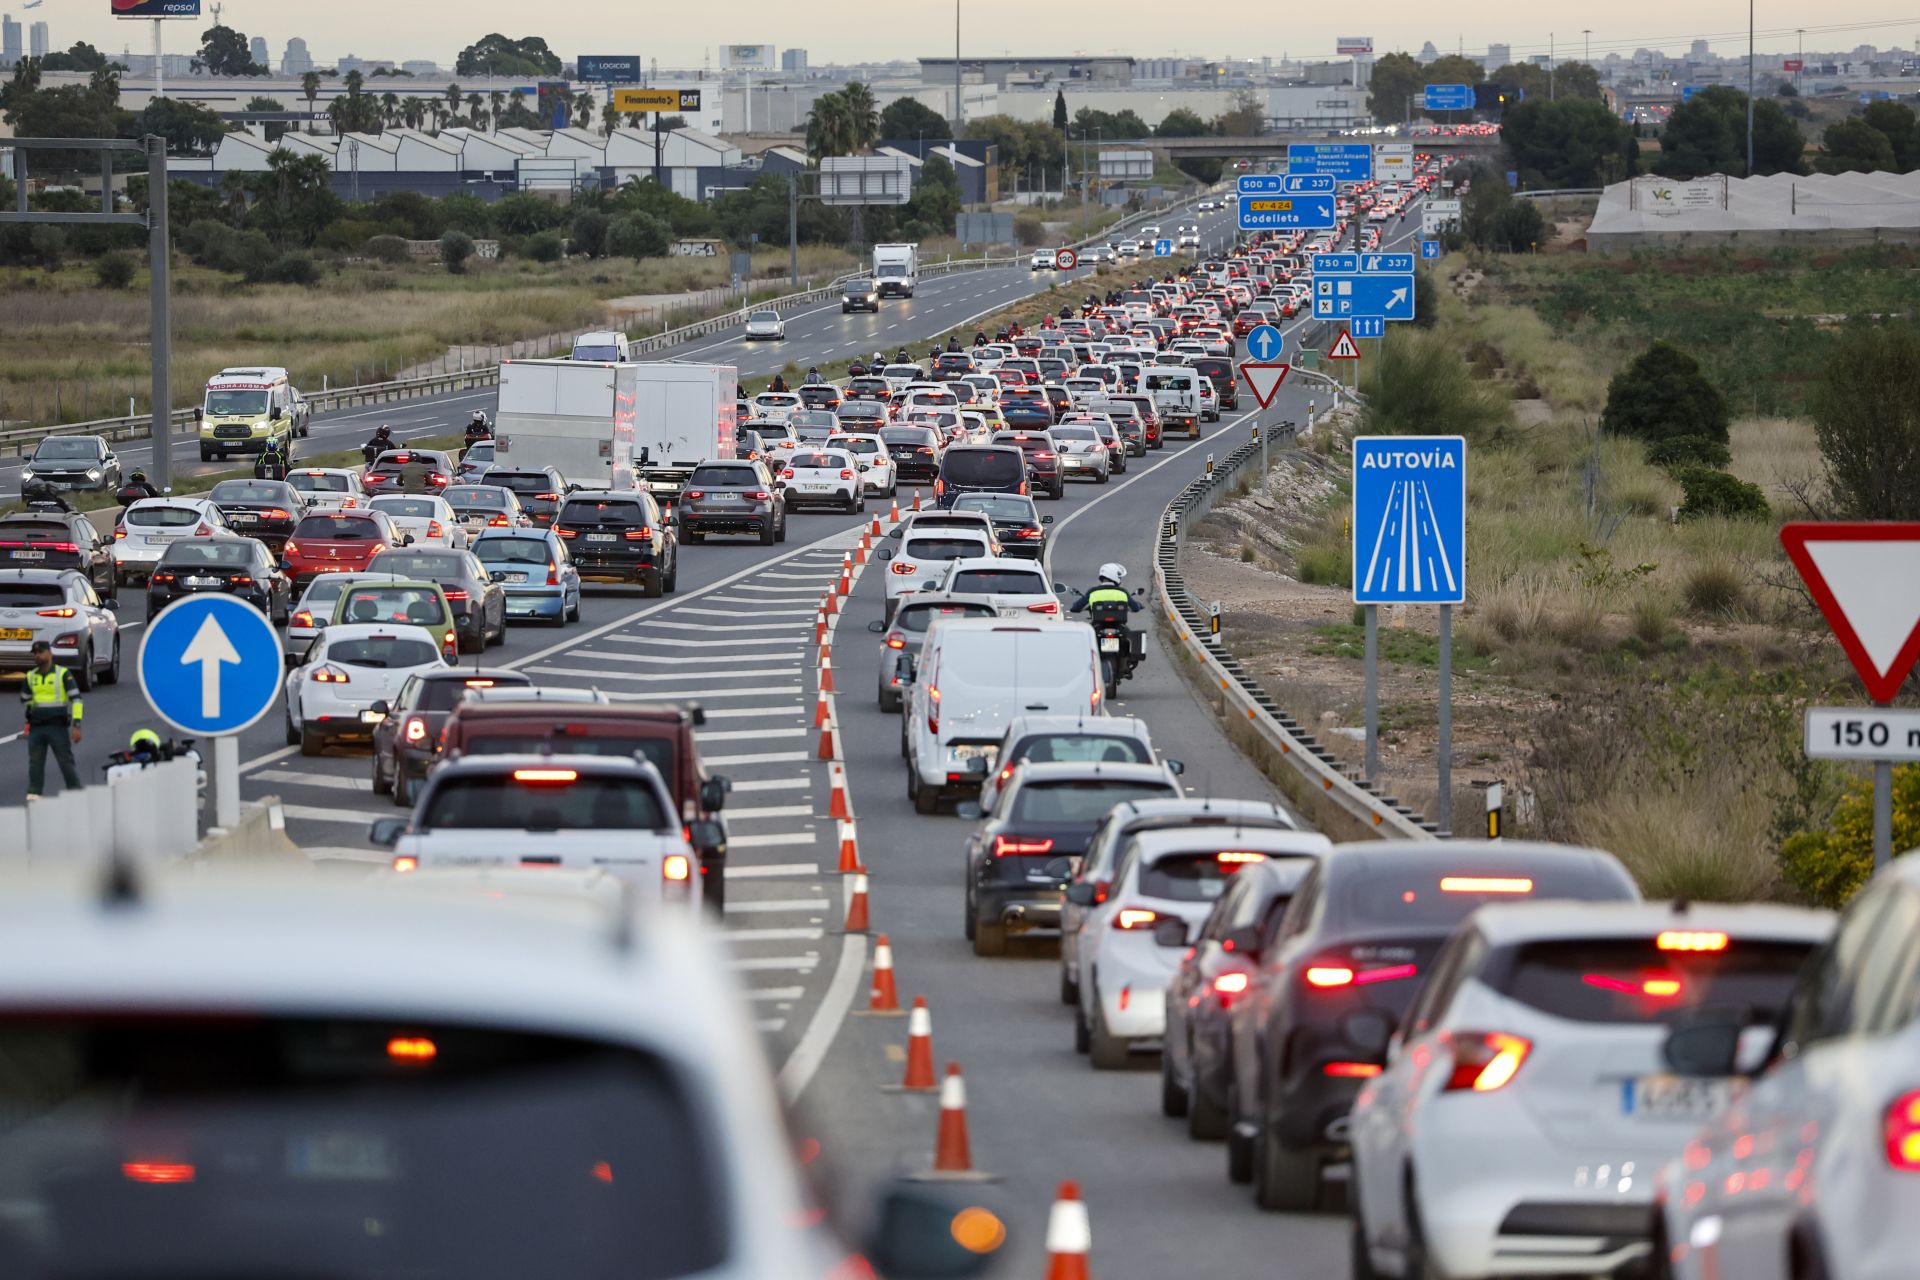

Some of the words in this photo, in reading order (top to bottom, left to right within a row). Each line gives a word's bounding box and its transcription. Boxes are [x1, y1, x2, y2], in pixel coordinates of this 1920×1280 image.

[163, 3, 195, 12] repsol
[598, 62, 630, 70] LOGICOR
[624, 95, 666, 105] Finanzauto
[680, 95, 699, 106] CAT
[1311, 179, 1330, 188] 337
[1251, 201, 1291, 210] CV-424
[1243, 213, 1300, 223] Godelleta
[1318, 259, 1340, 267] 750
[1387, 259, 1408, 267] 337
[1362, 447, 1455, 469] AUTOVÍA
[1830, 720, 1890, 747] 150
